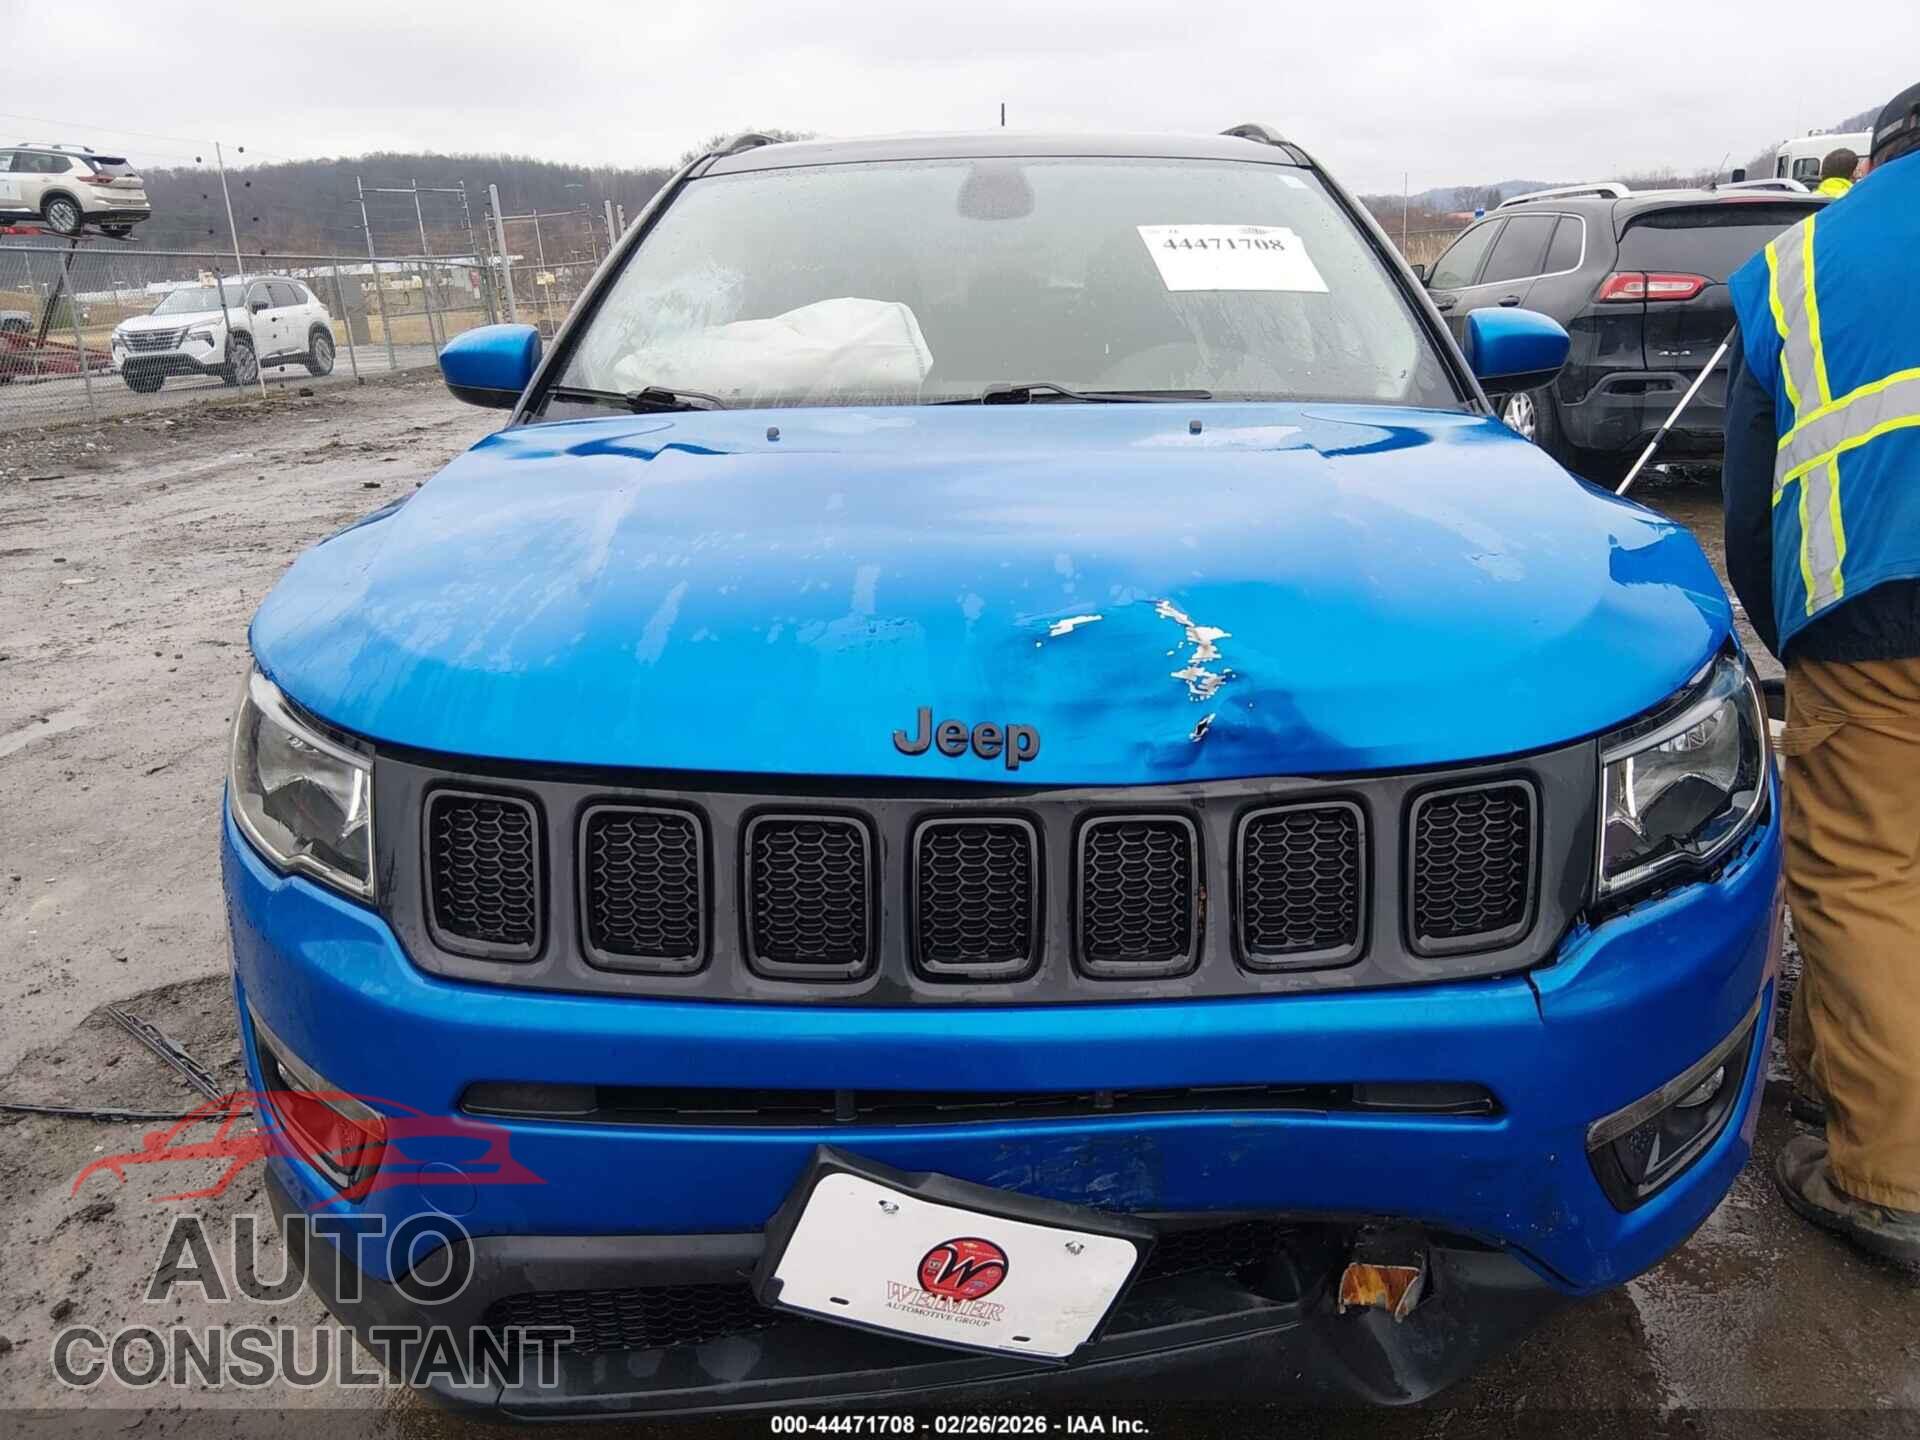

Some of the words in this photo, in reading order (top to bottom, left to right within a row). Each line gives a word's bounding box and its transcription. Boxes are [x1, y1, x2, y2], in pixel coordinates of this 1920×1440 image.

[1163, 238, 1285, 250] 44471708
[892, 706, 1041, 771] Jeep
[885, 1301, 953, 1321] AUTOMOTIVE
[954, 1316, 990, 1327] GROUP
